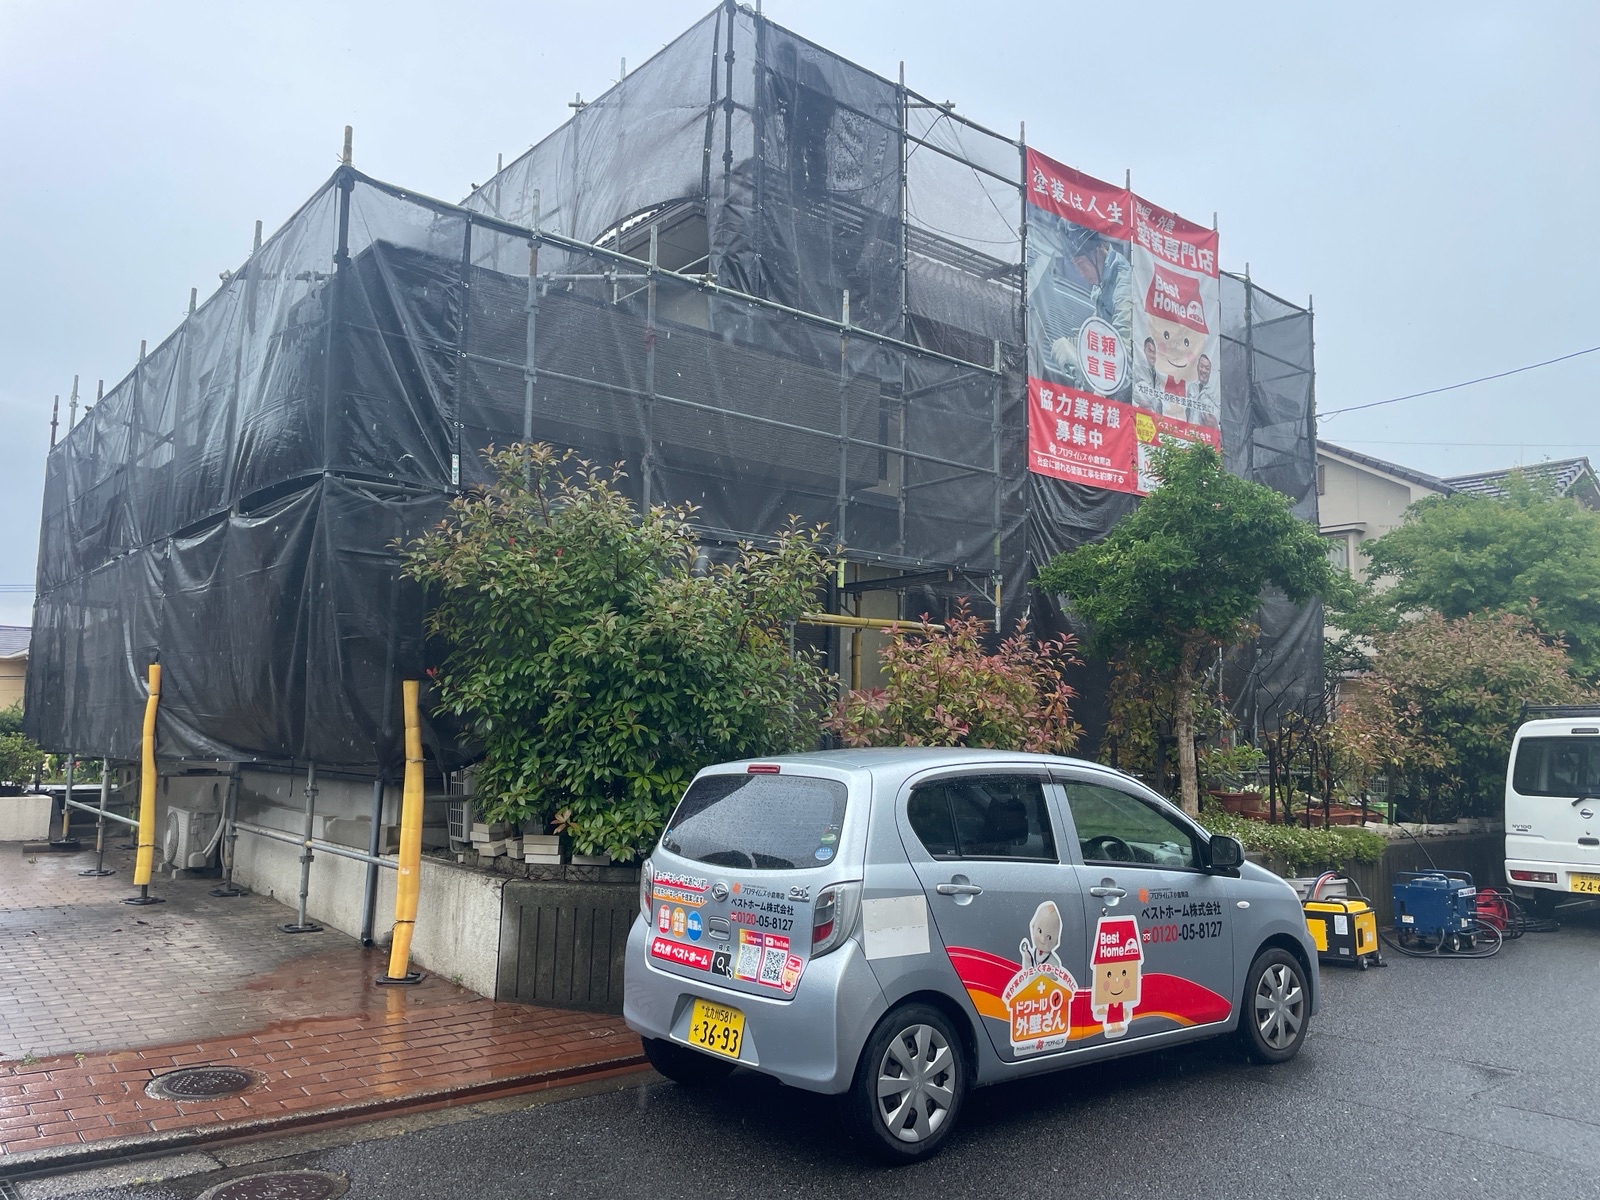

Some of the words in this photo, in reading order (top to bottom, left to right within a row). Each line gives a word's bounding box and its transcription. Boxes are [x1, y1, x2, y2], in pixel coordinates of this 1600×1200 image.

[1033, 167, 1124, 225] 塗装は人生
[1136, 217, 1214, 274] 塗装専門店
[1155, 274, 1180, 299] Best
[1153, 291, 1187, 318] Home
[1087, 329, 1116, 357] 信頼
[1087, 355, 1117, 382] 宣言
[1040, 387, 1120, 429] 協力業者様
[1056, 419, 1103, 449] 募集中
[731, 899, 794, 916] ベストホーム株式会社
[1141, 901, 1222, 919] ベストホーム株式会社
[737, 911, 794, 931] 0120-05-8127
[1152, 921, 1222, 943] 0120-05-8127
[1100, 931, 1120, 945] Best
[654, 941, 672, 955] 北九州
[672, 948, 708, 966] ベストホーム
[1100, 946, 1124, 958] Home
[1016, 998, 1047, 1015] ドクトル
[1016, 1010, 1065, 1037] 外壁さん
